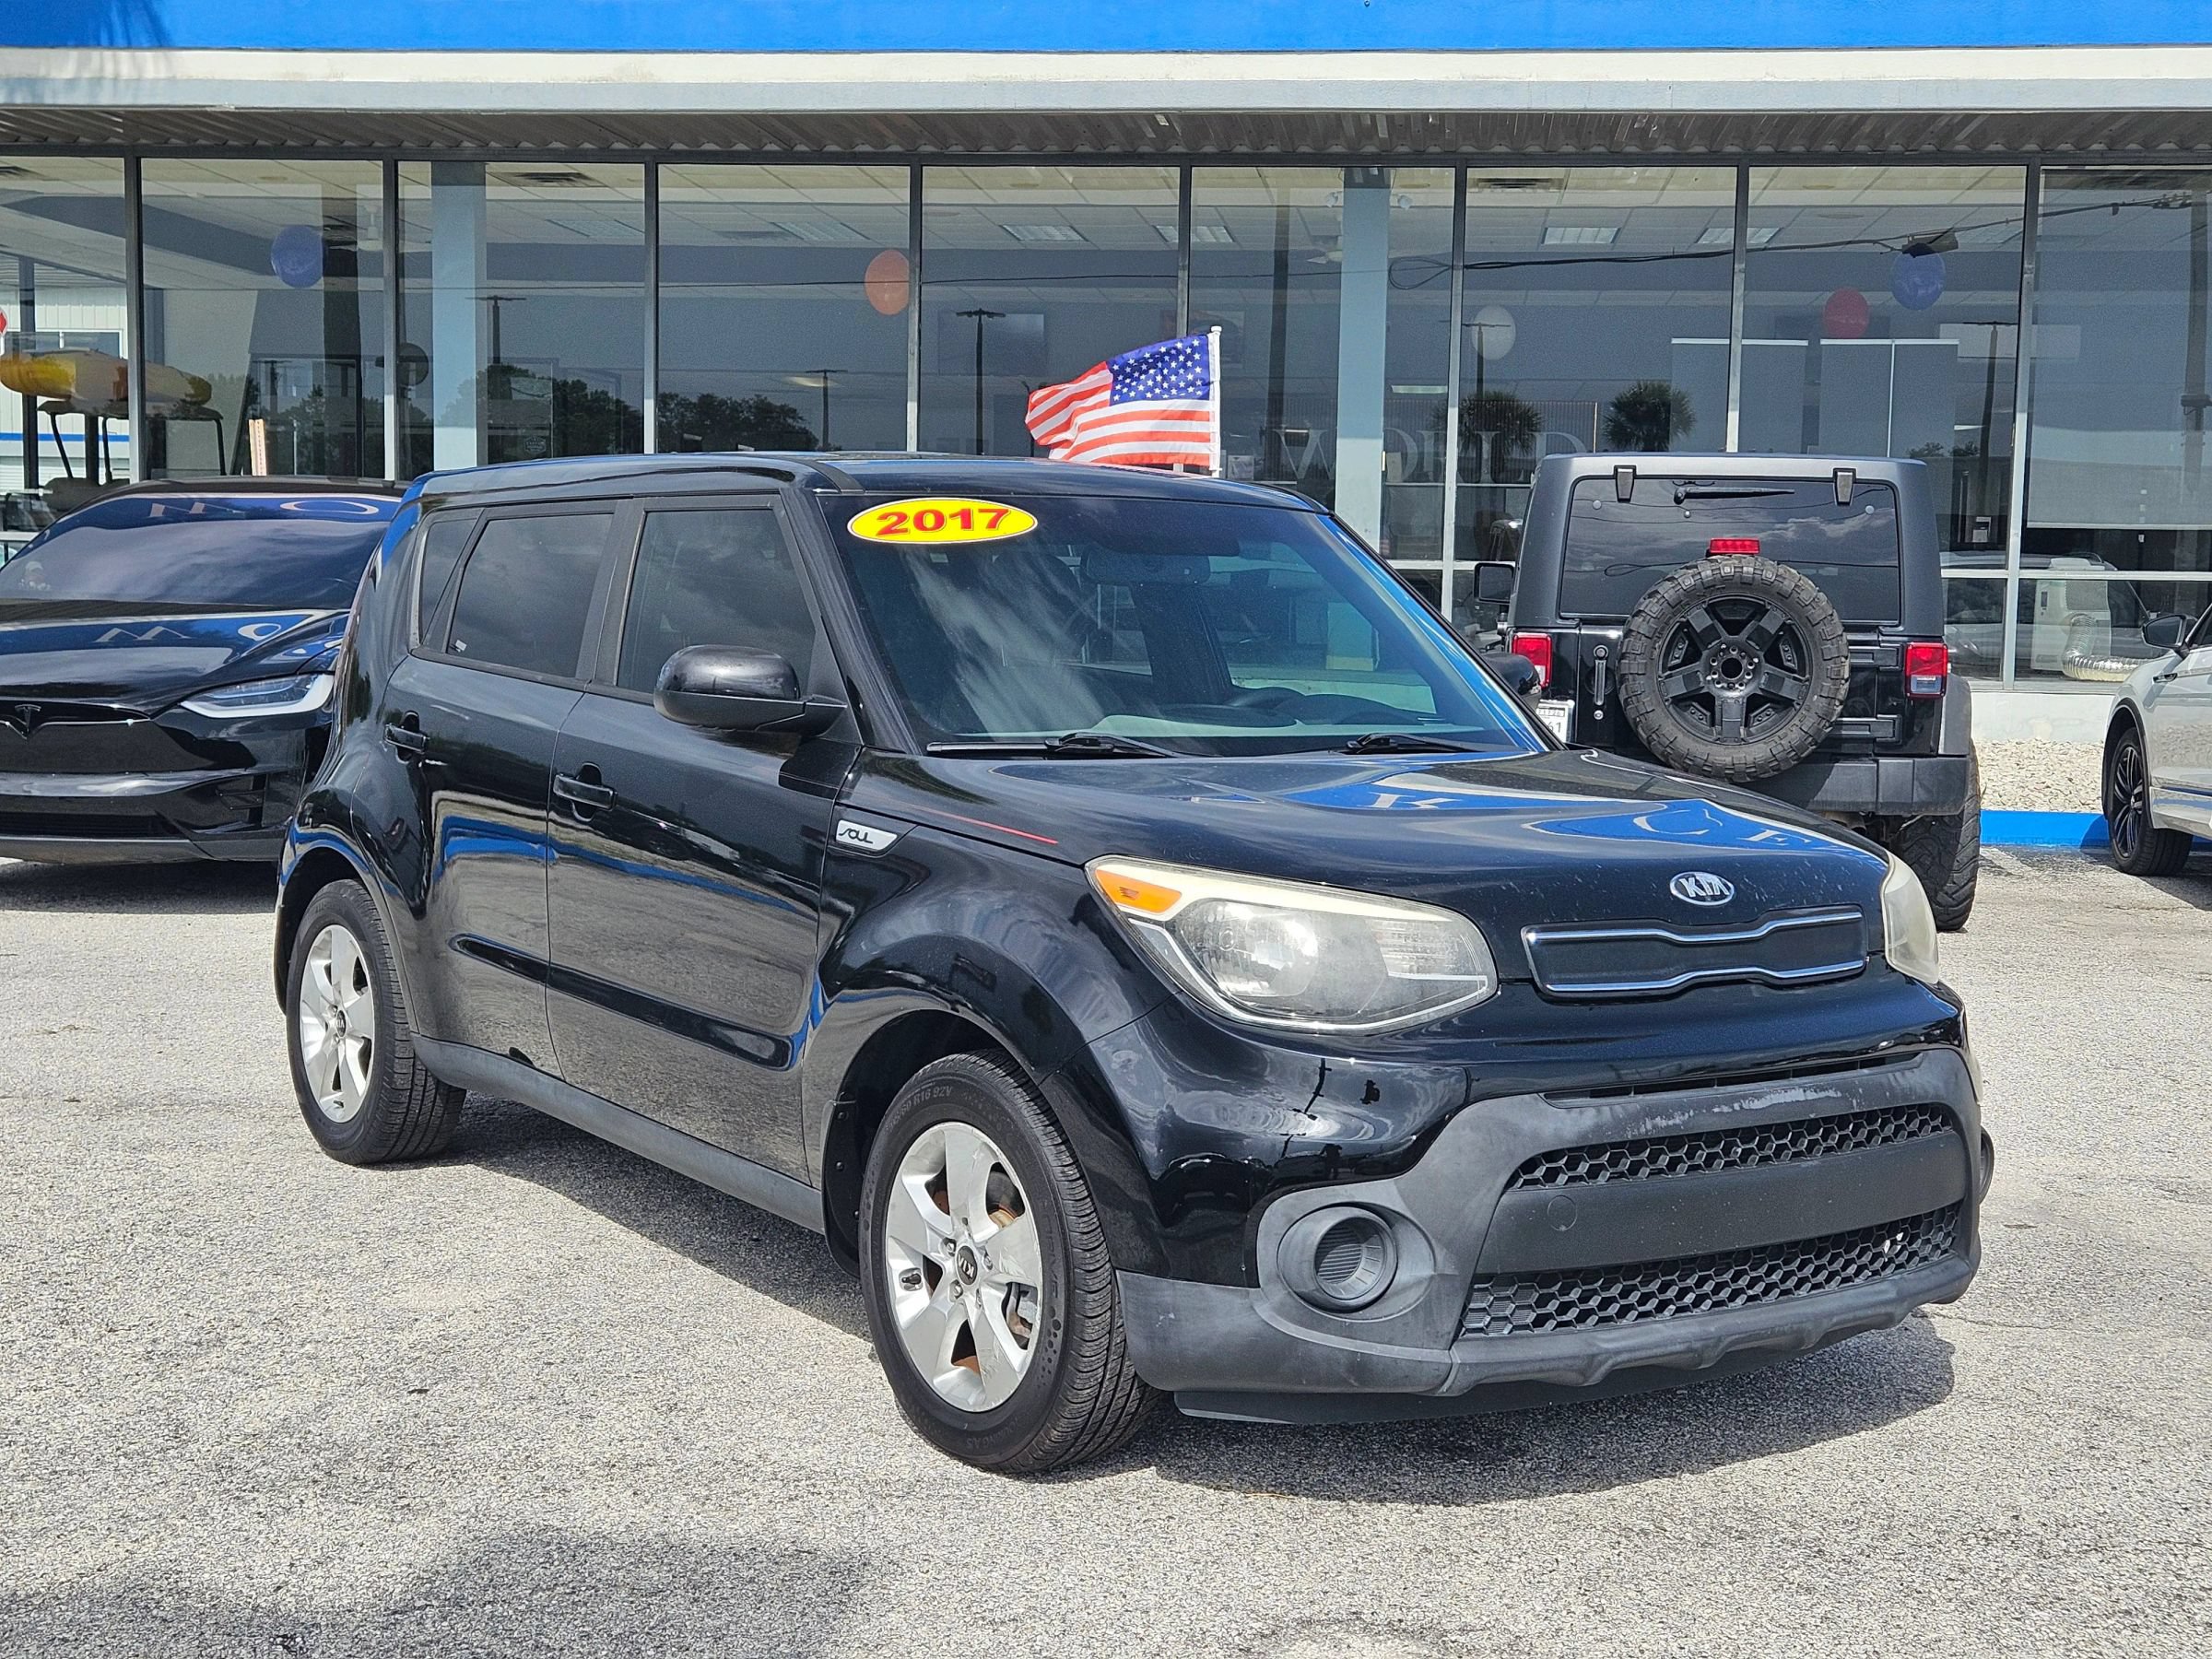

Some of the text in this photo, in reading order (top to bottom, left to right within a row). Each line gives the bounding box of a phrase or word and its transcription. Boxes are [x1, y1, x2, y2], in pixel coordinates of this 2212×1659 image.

[877, 508, 1011, 536] 2017
[1678, 876, 1730, 898] KIA
[958, 1253, 974, 1278] KIA
